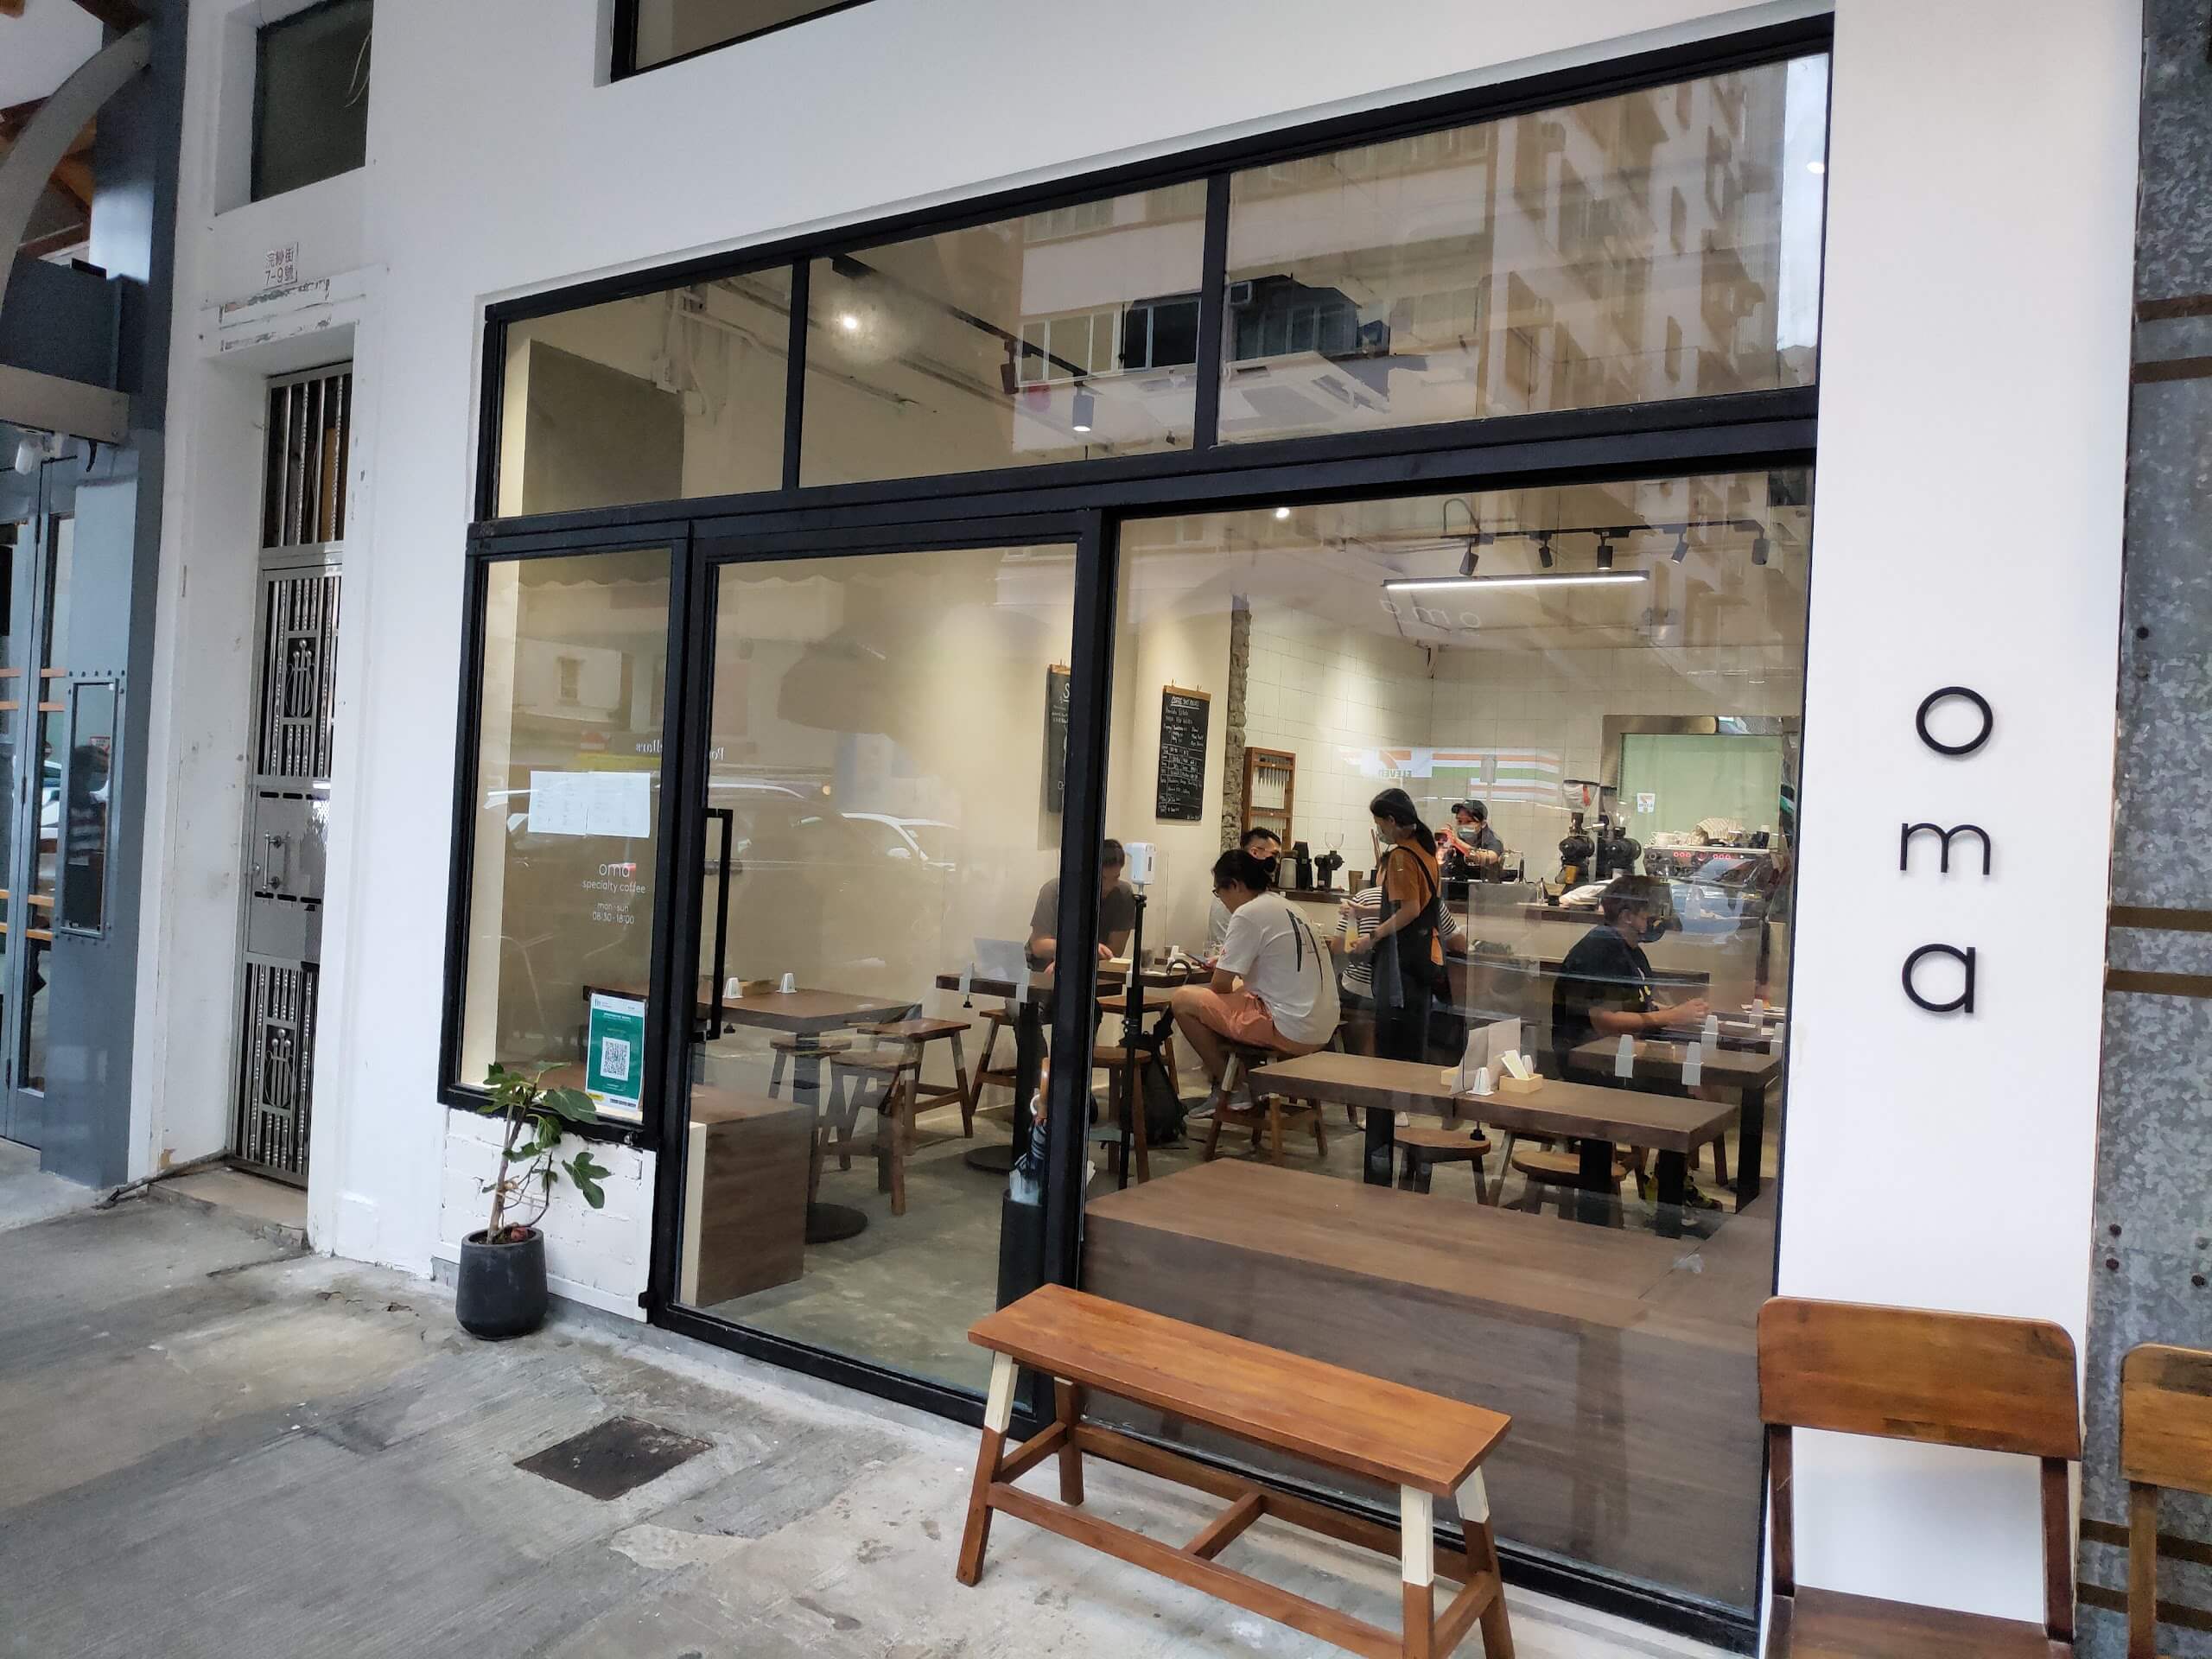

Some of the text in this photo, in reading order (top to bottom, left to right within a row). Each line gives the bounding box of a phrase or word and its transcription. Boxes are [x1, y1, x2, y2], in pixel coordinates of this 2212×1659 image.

[1899, 686, 1994, 1014] oma
[599, 863, 630, 879] oma
[582, 880, 646, 893] specialty coffee
